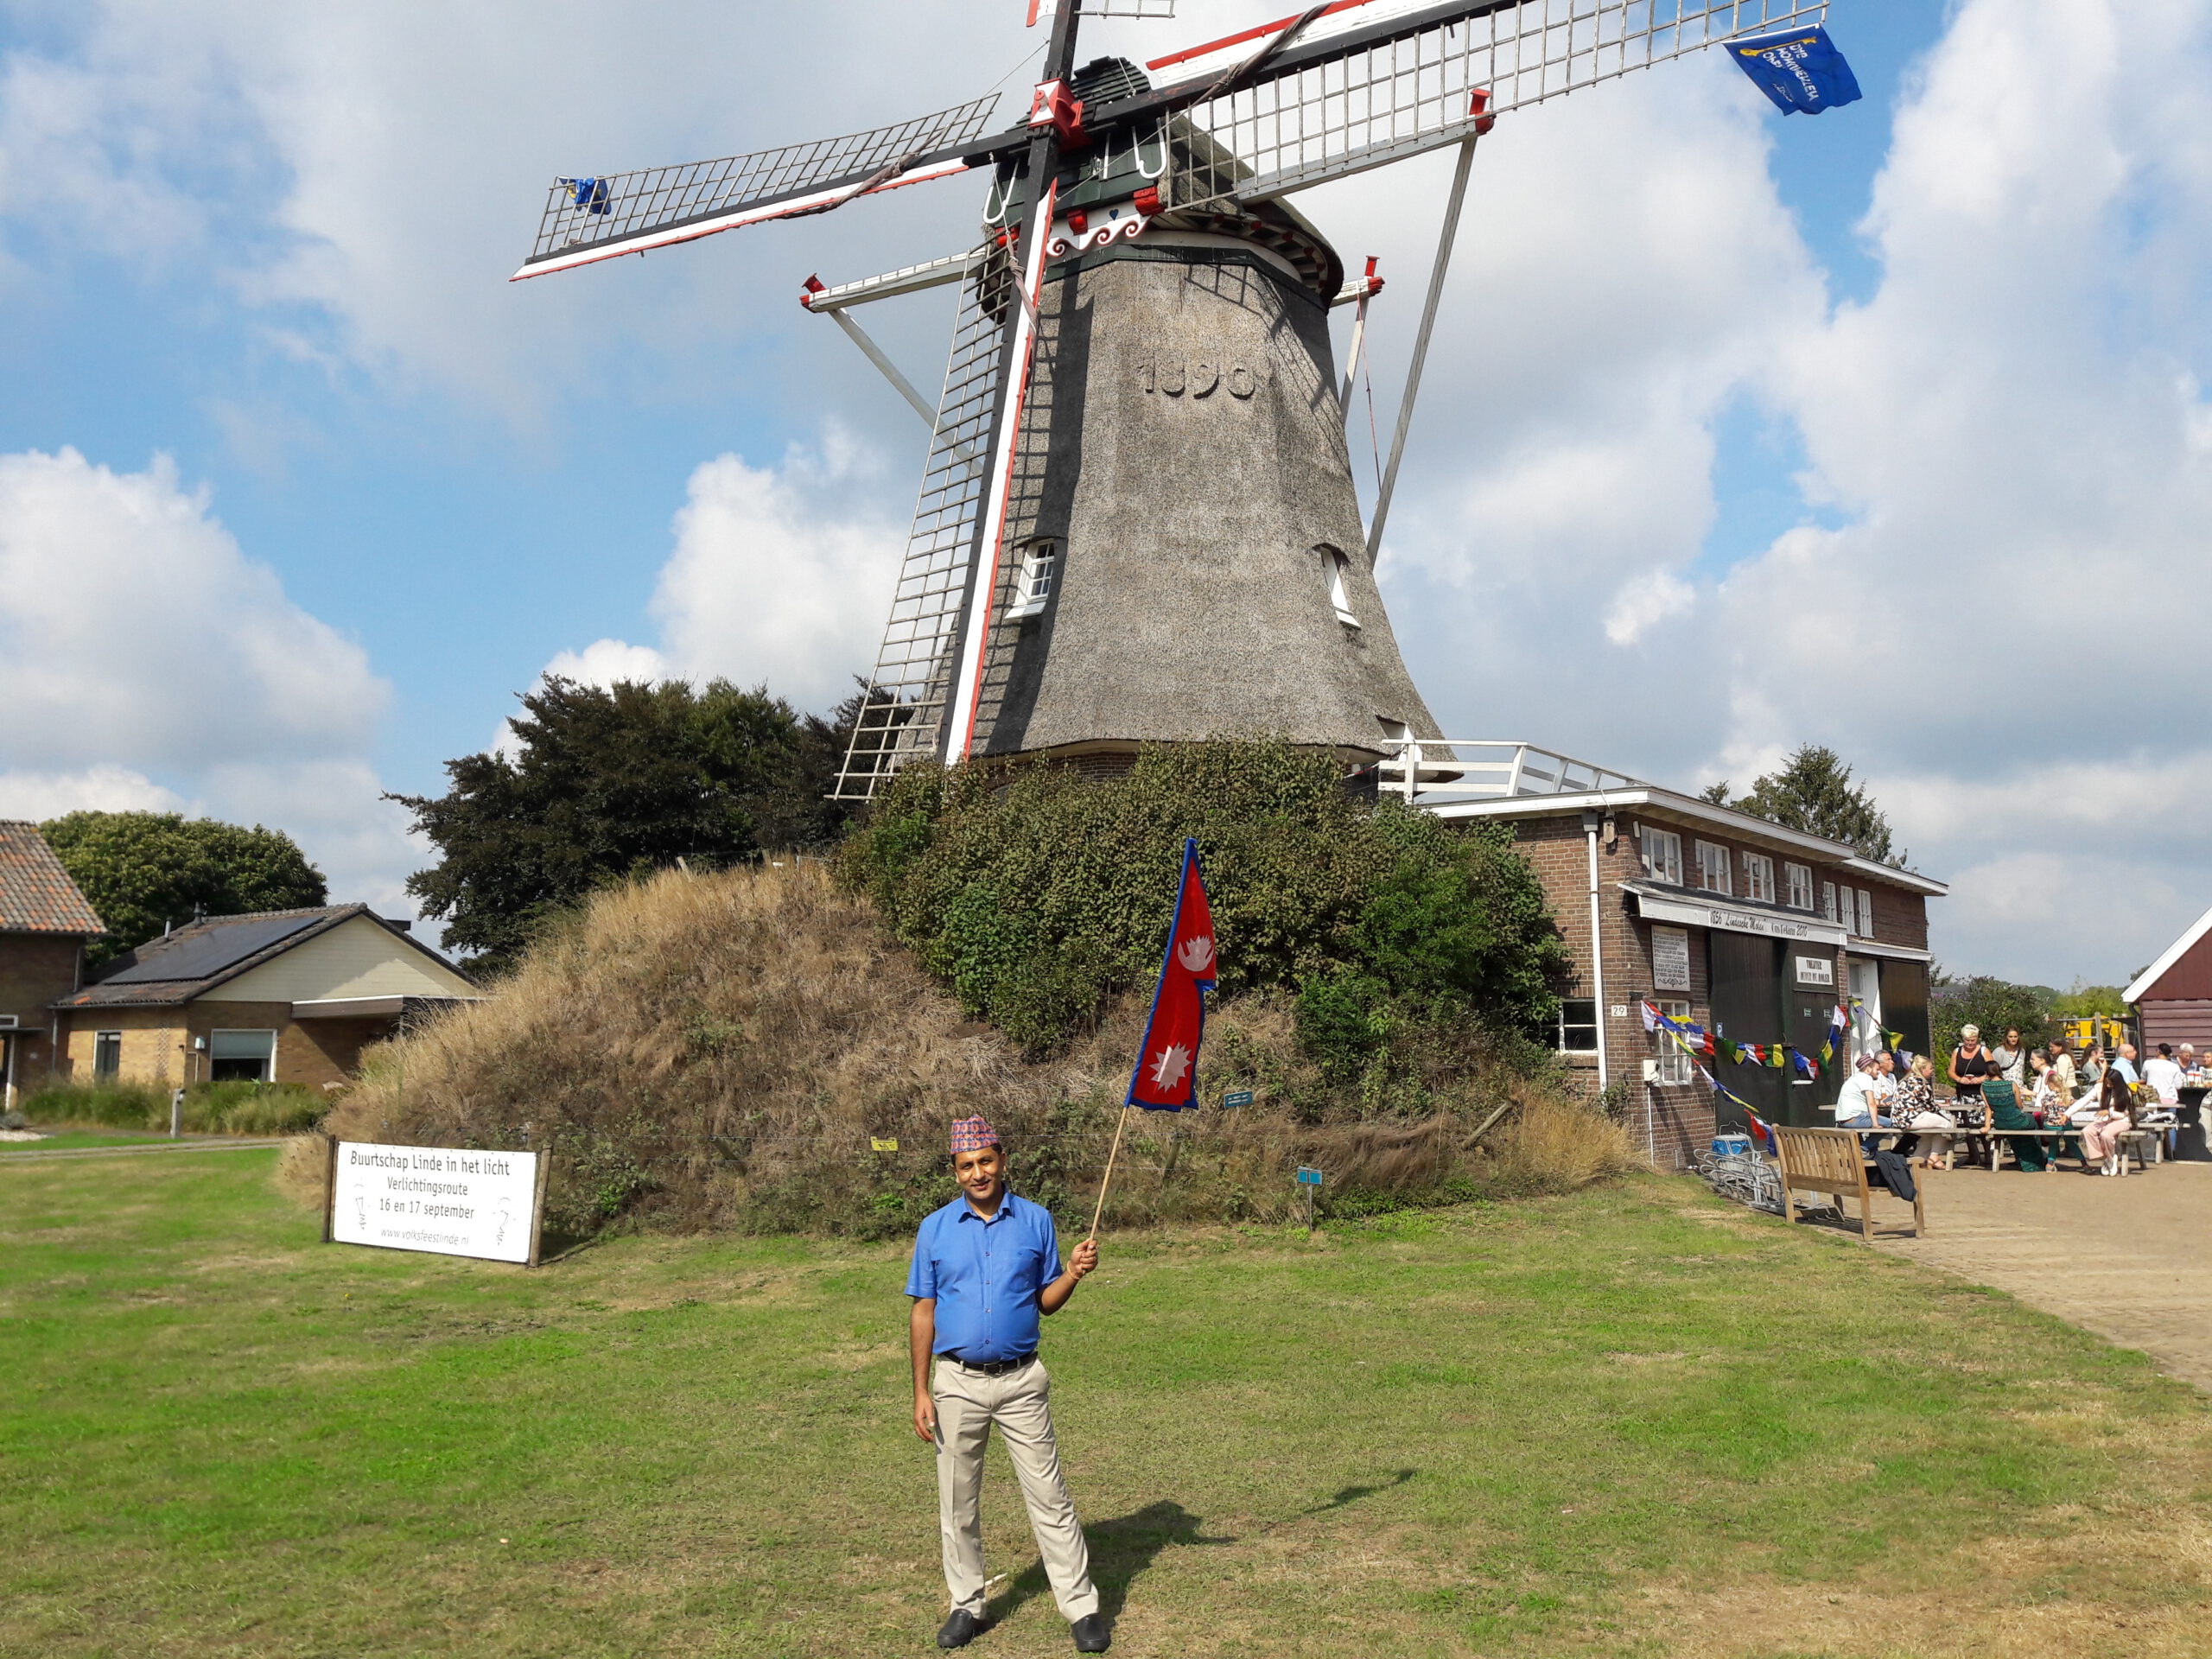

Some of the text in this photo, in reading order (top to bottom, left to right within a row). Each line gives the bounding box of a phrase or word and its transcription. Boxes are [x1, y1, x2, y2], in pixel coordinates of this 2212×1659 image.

[1612, 1007, 1624, 1016] 29
[350, 1150, 510, 1176] Buurtschap Linde in het licht
[387, 1175, 468, 1197] Verlichtingsroute
[379, 1198, 474, 1219] 16 en 17 september
